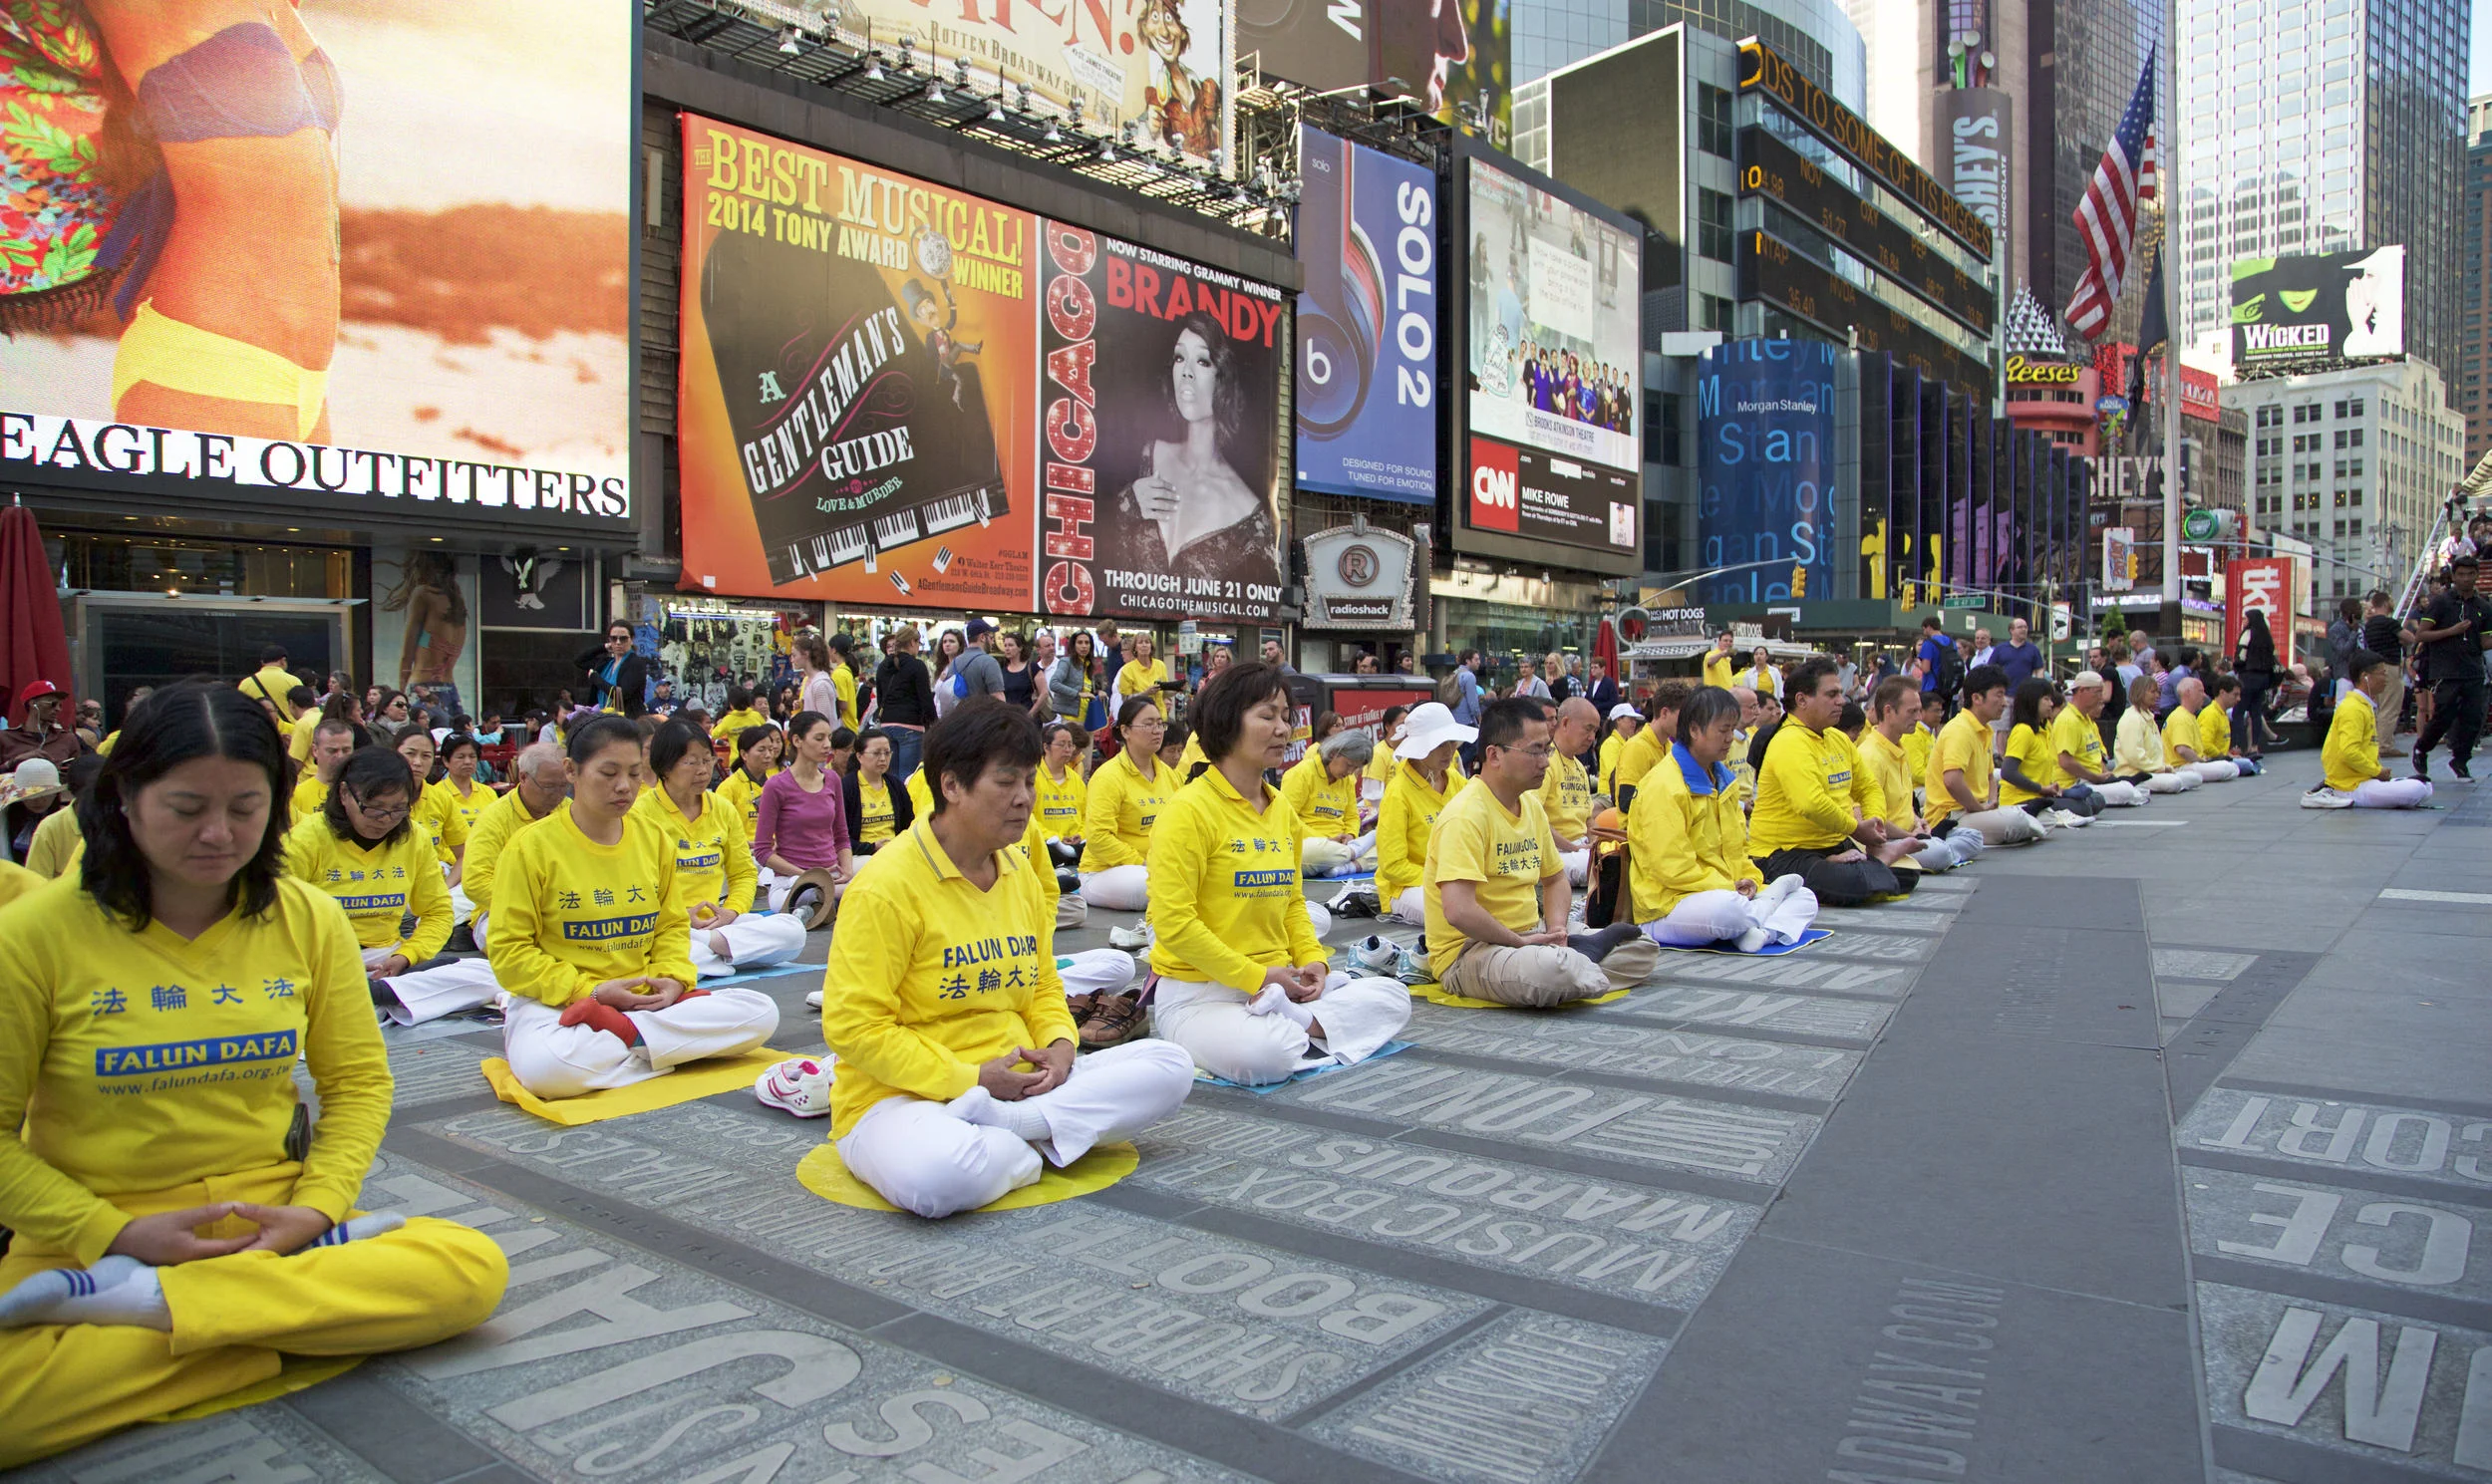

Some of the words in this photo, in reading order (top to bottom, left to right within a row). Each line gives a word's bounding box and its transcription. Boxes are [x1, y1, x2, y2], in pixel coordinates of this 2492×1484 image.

[1833, 104, 1884, 175] SOME
[1889, 151, 1911, 191] OF
[707, 129, 827, 214] BEST
[837, 165, 1024, 267] MUSICAL!
[707, 192, 767, 238] 2014
[773, 209, 833, 253] TONY
[836, 226, 909, 271] AWARD
[952, 256, 1024, 300] WINNER
[1106, 237, 1137, 258] NOW
[1139, 249, 1191, 275] STARRING
[1194, 262, 1240, 289] GRAMMY
[1243, 280, 1282, 302] WINNER
[1107, 255, 1282, 349] BRANDY
[743, 306, 906, 496] GENTLEMAN'S
[758, 370, 786, 404] A
[1045, 217, 1096, 615] CHICAGO
[1737, 400, 1779, 414] Morgan
[1780, 399, 1817, 416] Stanley
[0, 413, 235, 479] EAGLE
[260, 443, 628, 516] OUTFITTERS
[820, 426, 915, 481] GUIDE
[1343, 457, 1383, 471] DESIGNED
[1385, 463, 1403, 474] FOR
[815, 497, 846, 513] LOVE
[855, 476, 903, 505] MURDER
[1348, 470, 1376, 483] TUNED
[1378, 474, 1396, 485] FOR
[1473, 465, 1515, 509] CNN
[1522, 486, 1544, 503] MIKE
[1545, 492, 1569, 509] ROWE
[966, 558, 988, 569] Walter
[989, 561, 1004, 571] Kerr
[1005, 562, 1029, 572] Theatre
[1103, 569, 1181, 593] THROUGH
[1184, 579, 1221, 596] JUNE
[1225, 581, 1242, 598] 21
[1246, 584, 1283, 603] ONLY
[1119, 593, 1269, 618] CHICAGOTHEMUSICAL.COM
[1330, 604, 1389, 617] radioshack
[1663, 608, 1680, 621] HOT
[1681, 607, 1705, 620] DOGS
[1239, 873, 1276, 885] FALUN
[372, 896, 403, 906] DAFA
[569, 921, 624, 937] FALUN
[943, 938, 1004, 969] FALUN
[91, 977, 295, 1017] 法輪大法
[104, 1043, 207, 1072] FALUN
[219, 1035, 292, 1060] DAFA
[97, 1062, 292, 1095] www.falundafa.org.tw
[1216, 1167, 1395, 1223] BOX
[1289, 1139, 1735, 1245] MARQUIS
[1370, 1202, 1699, 1293] MUSIC
[1014, 1213, 1446, 1346] BOOTH
